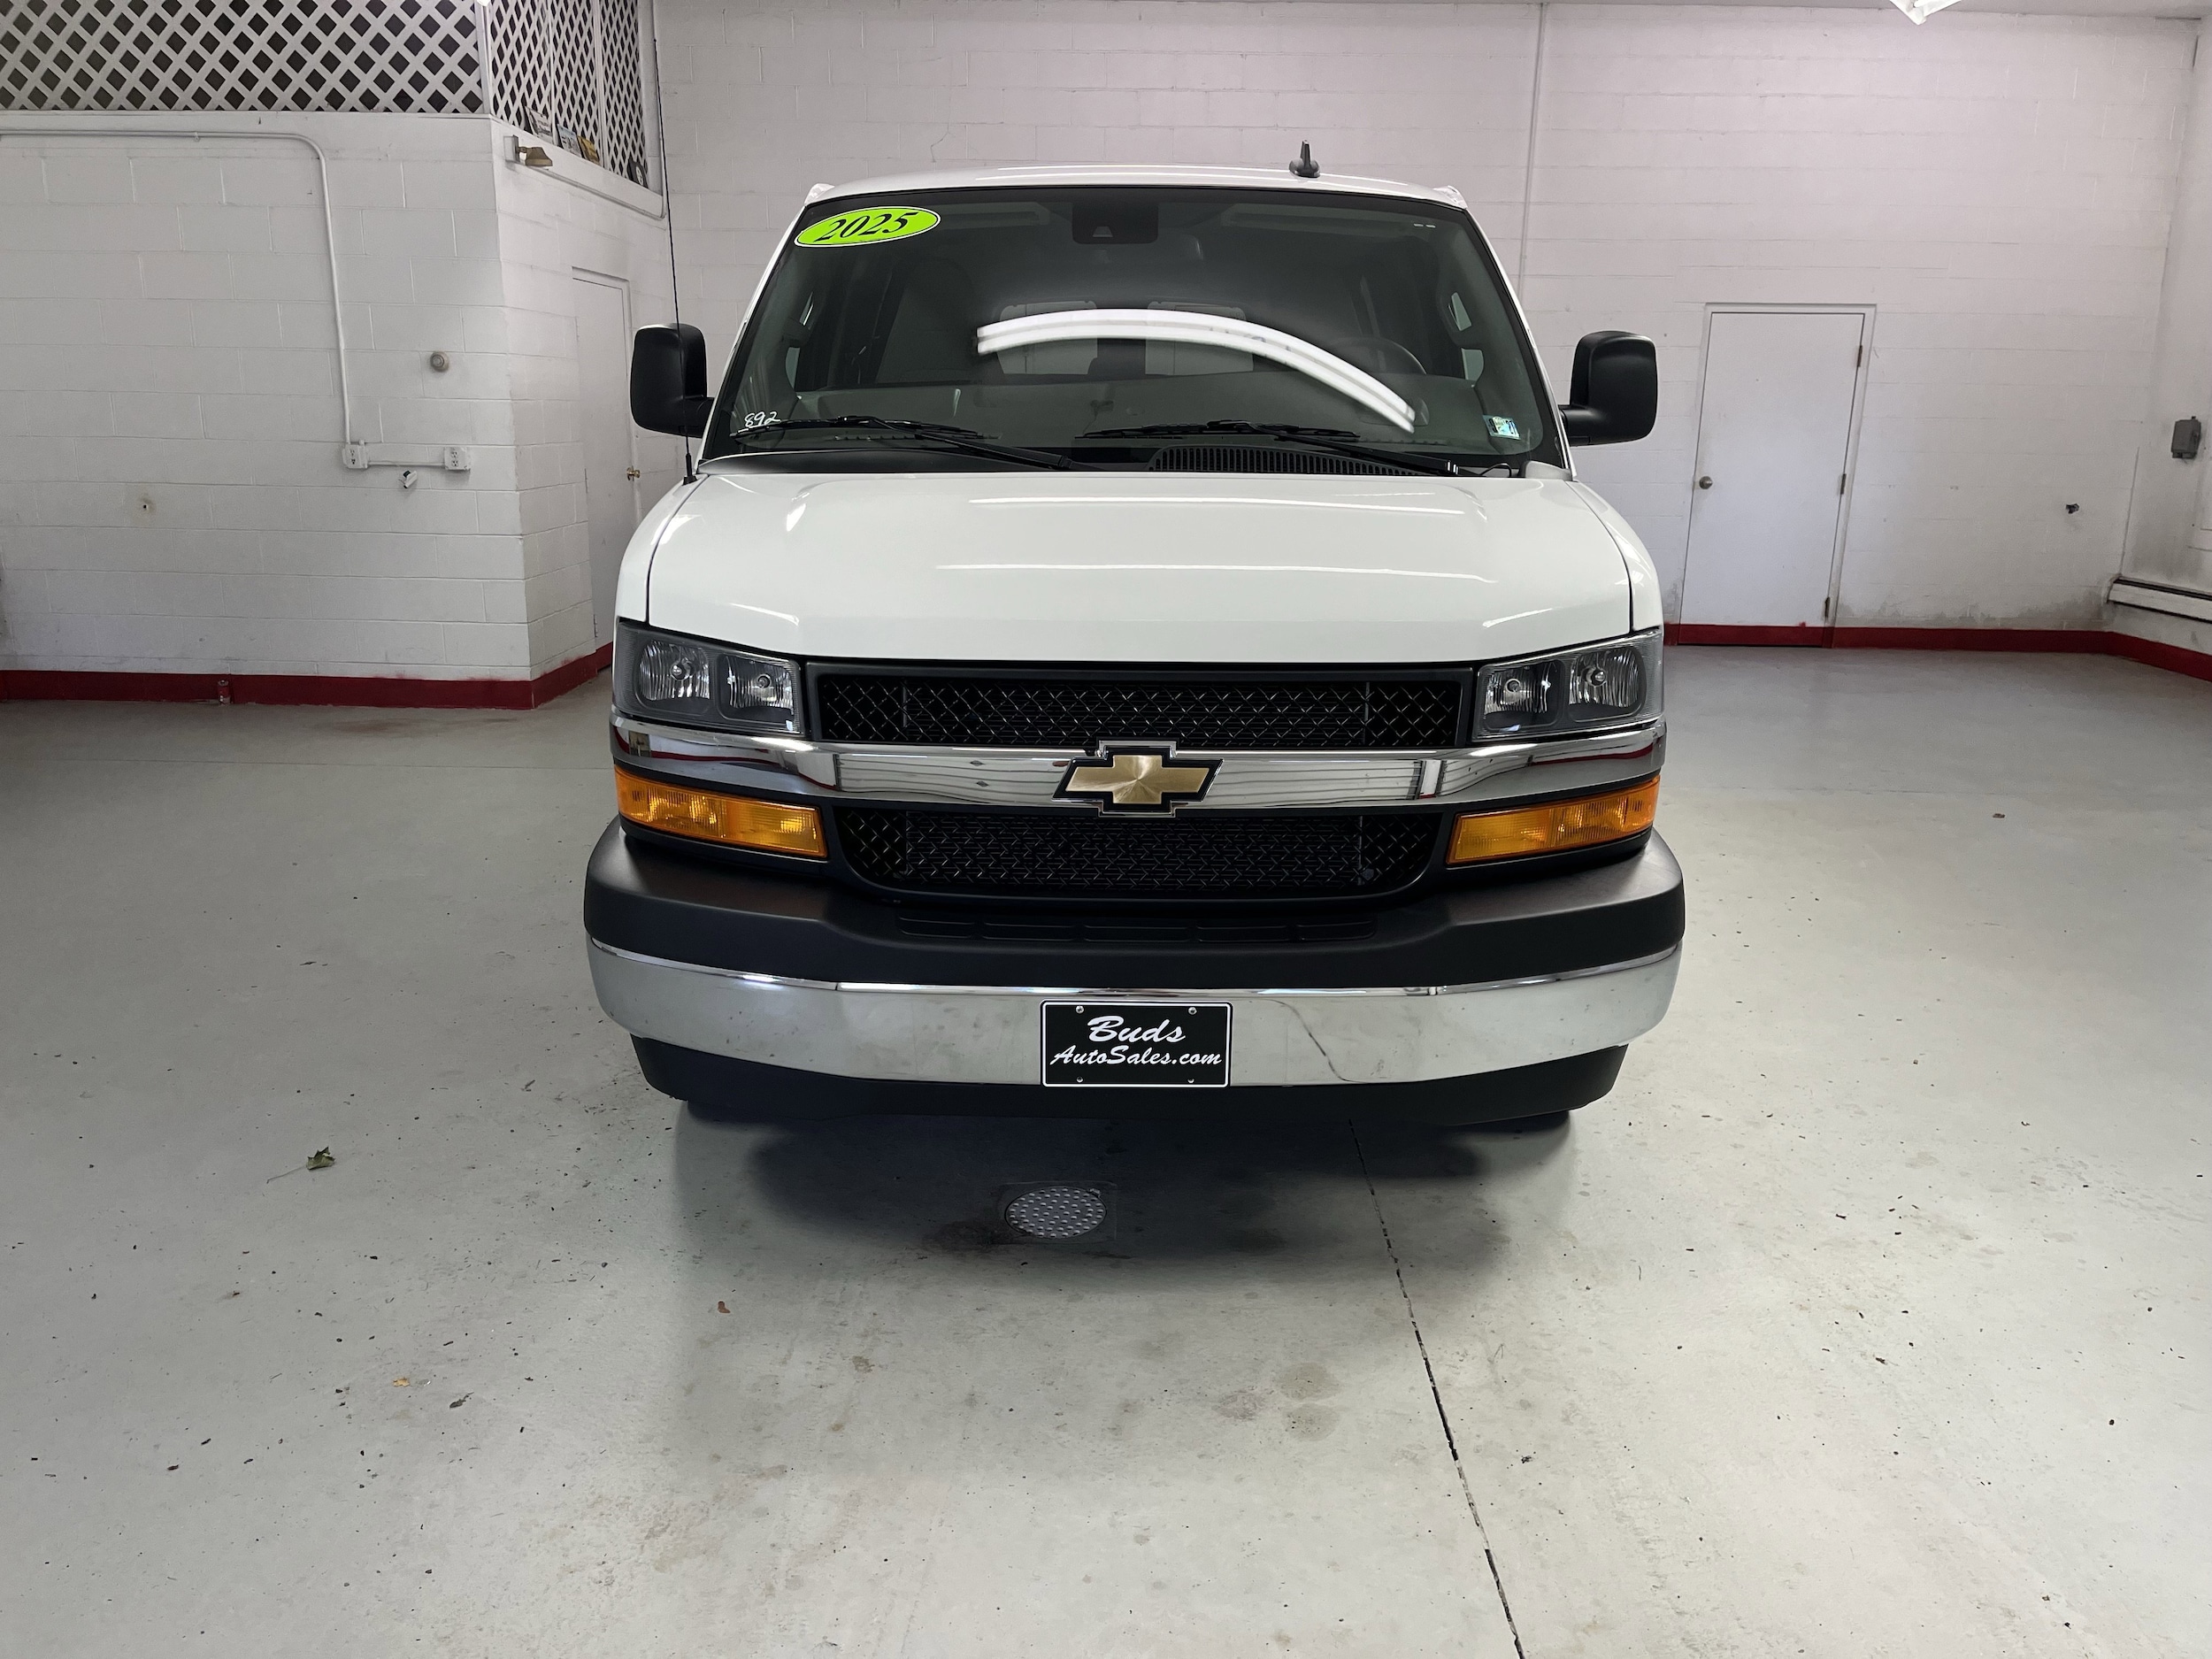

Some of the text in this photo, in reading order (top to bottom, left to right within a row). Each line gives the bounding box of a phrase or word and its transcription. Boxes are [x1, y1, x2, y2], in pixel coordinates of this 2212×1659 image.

[813, 211, 918, 242] 2025
[744, 411, 781, 428] 892
[1087, 1015, 1187, 1043] Buds
[1049, 1044, 1223, 1065] AutoSales.com
